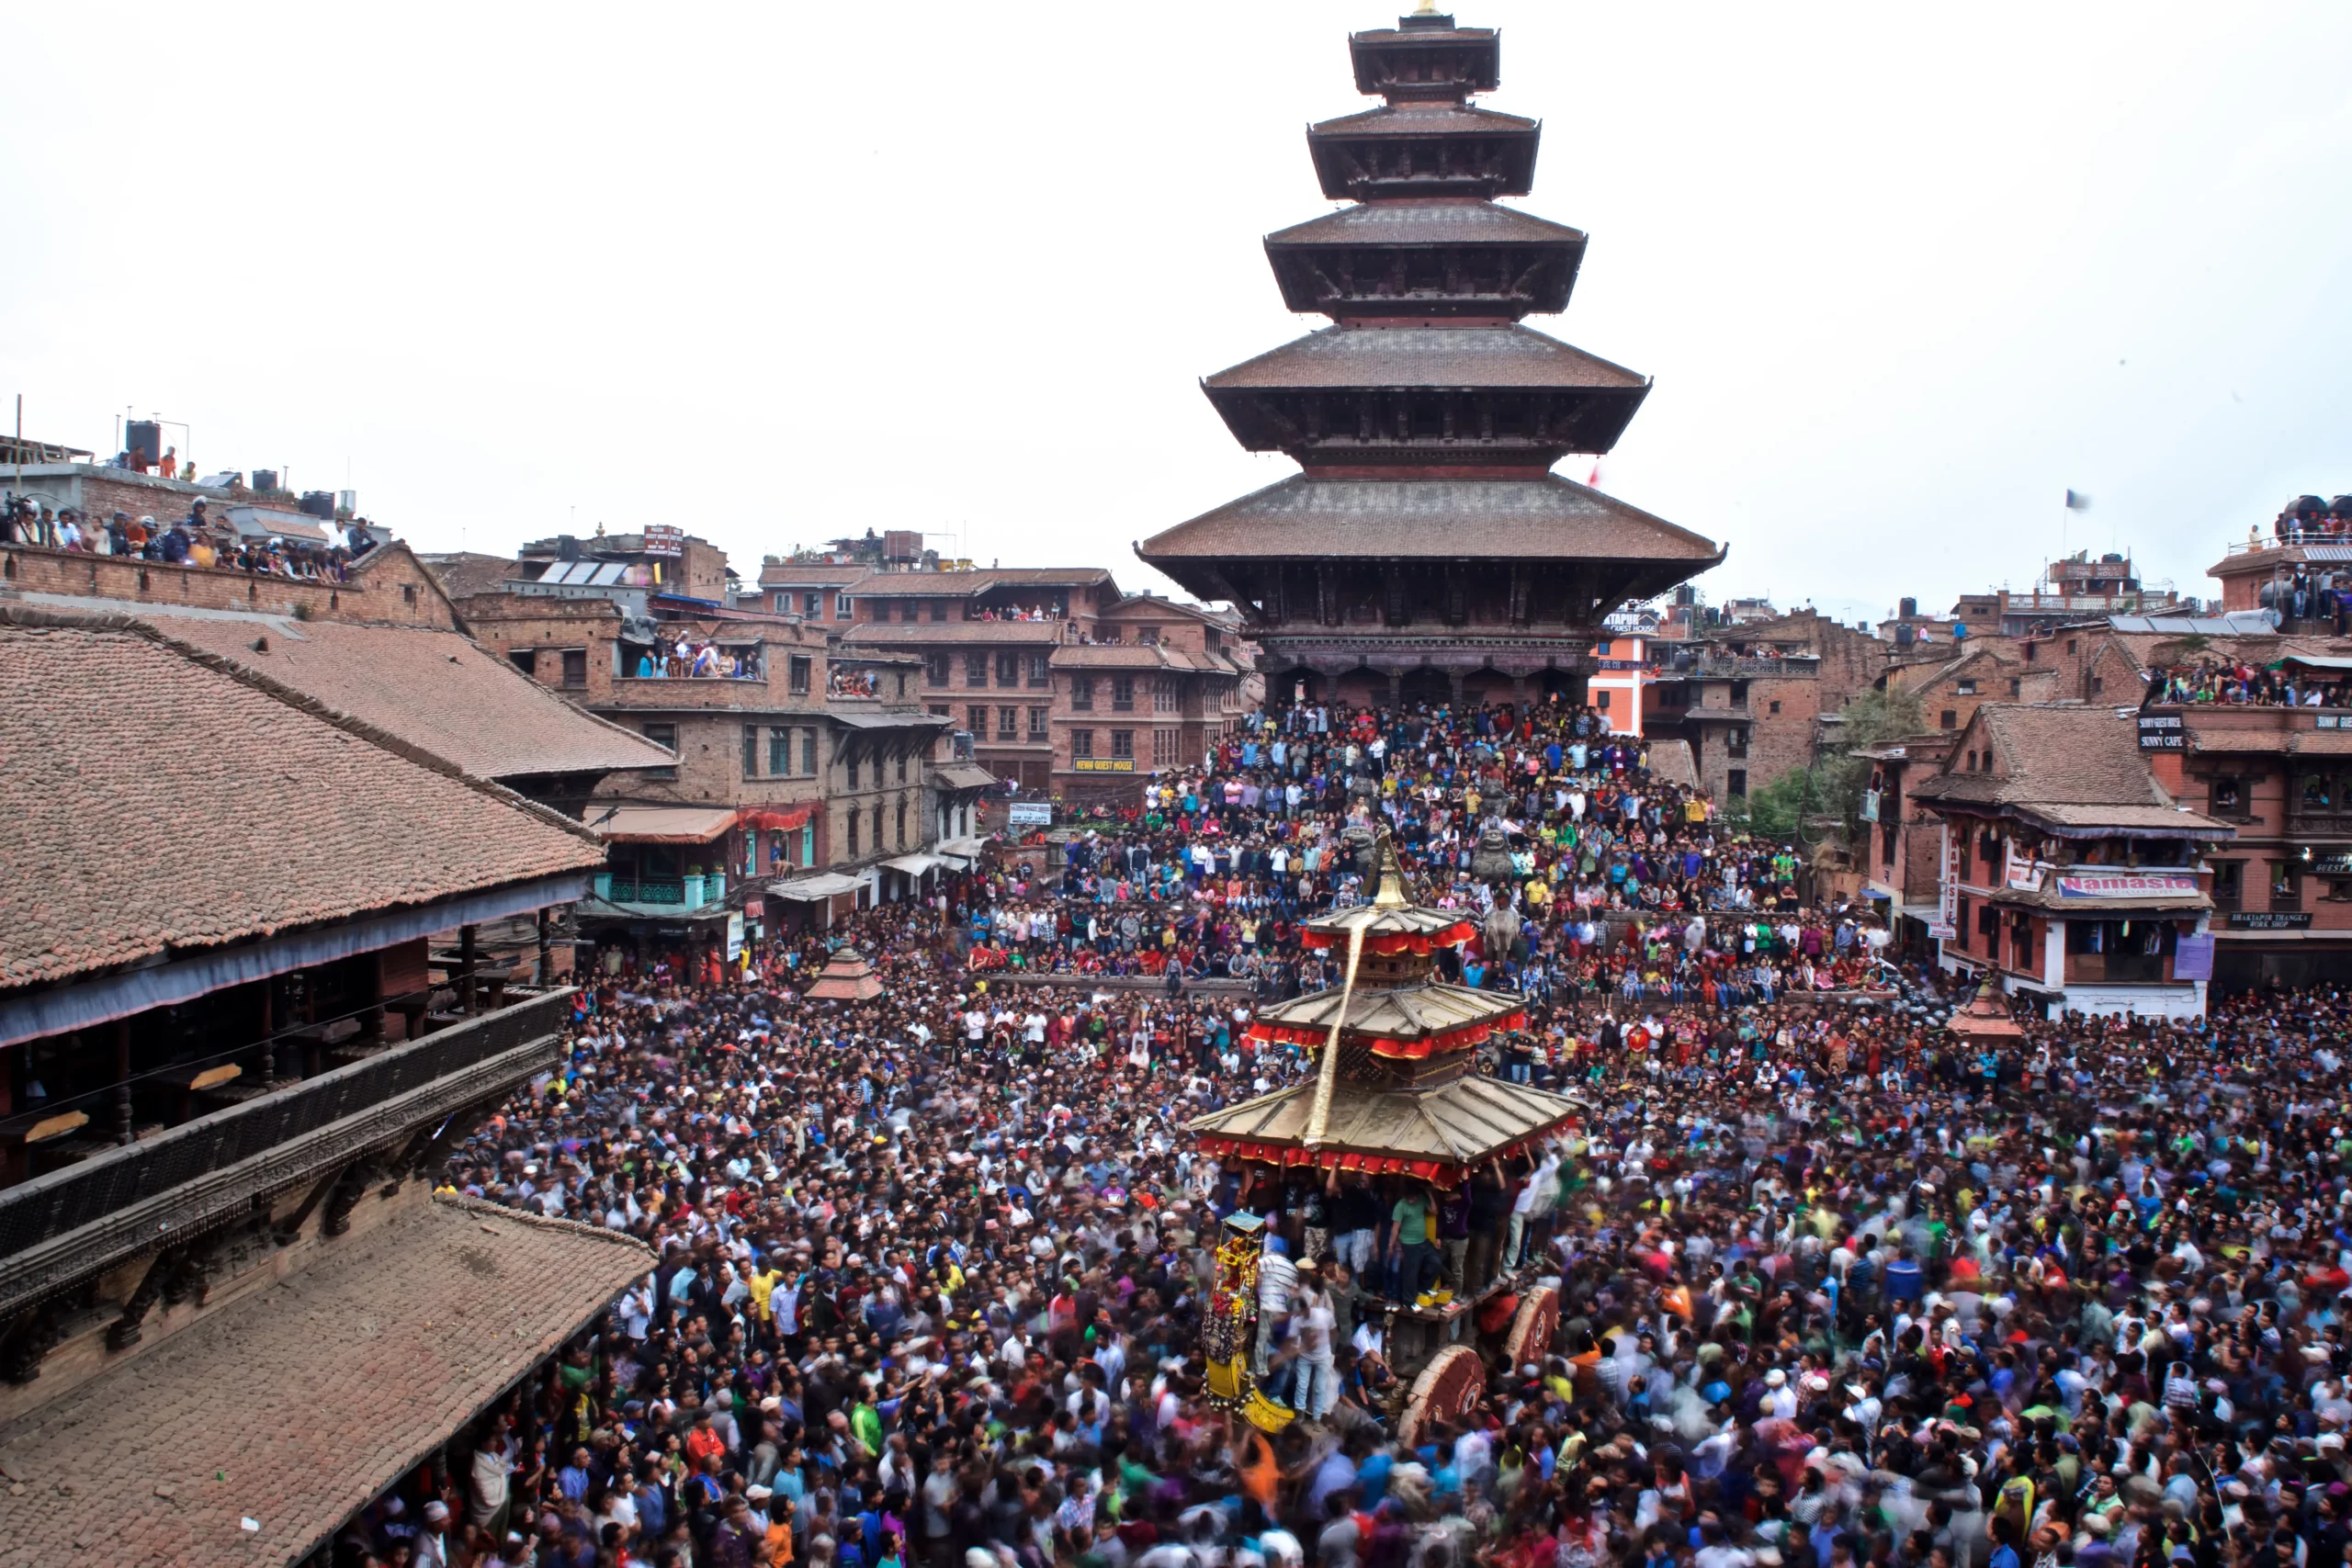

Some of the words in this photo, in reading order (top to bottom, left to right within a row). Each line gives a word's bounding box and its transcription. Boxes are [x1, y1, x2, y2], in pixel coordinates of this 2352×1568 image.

[2140, 717, 2154, 728] SUNNY
[2166, 717, 2181, 728] HOUSE
[2317, 716, 2337, 728] SUNNY
[2339, 716, 2352, 728] GUE
[2141, 736, 2163, 746] SUNNY
[2165, 736, 2183, 746] CAFE
[1076, 760, 1093, 771] NEWA
[1094, 761, 1113, 771] GUEST
[1114, 761, 1133, 771] HOUSE
[1949, 839, 1958, 919] NAMASTE
[2064, 877, 2193, 889] Namaste
